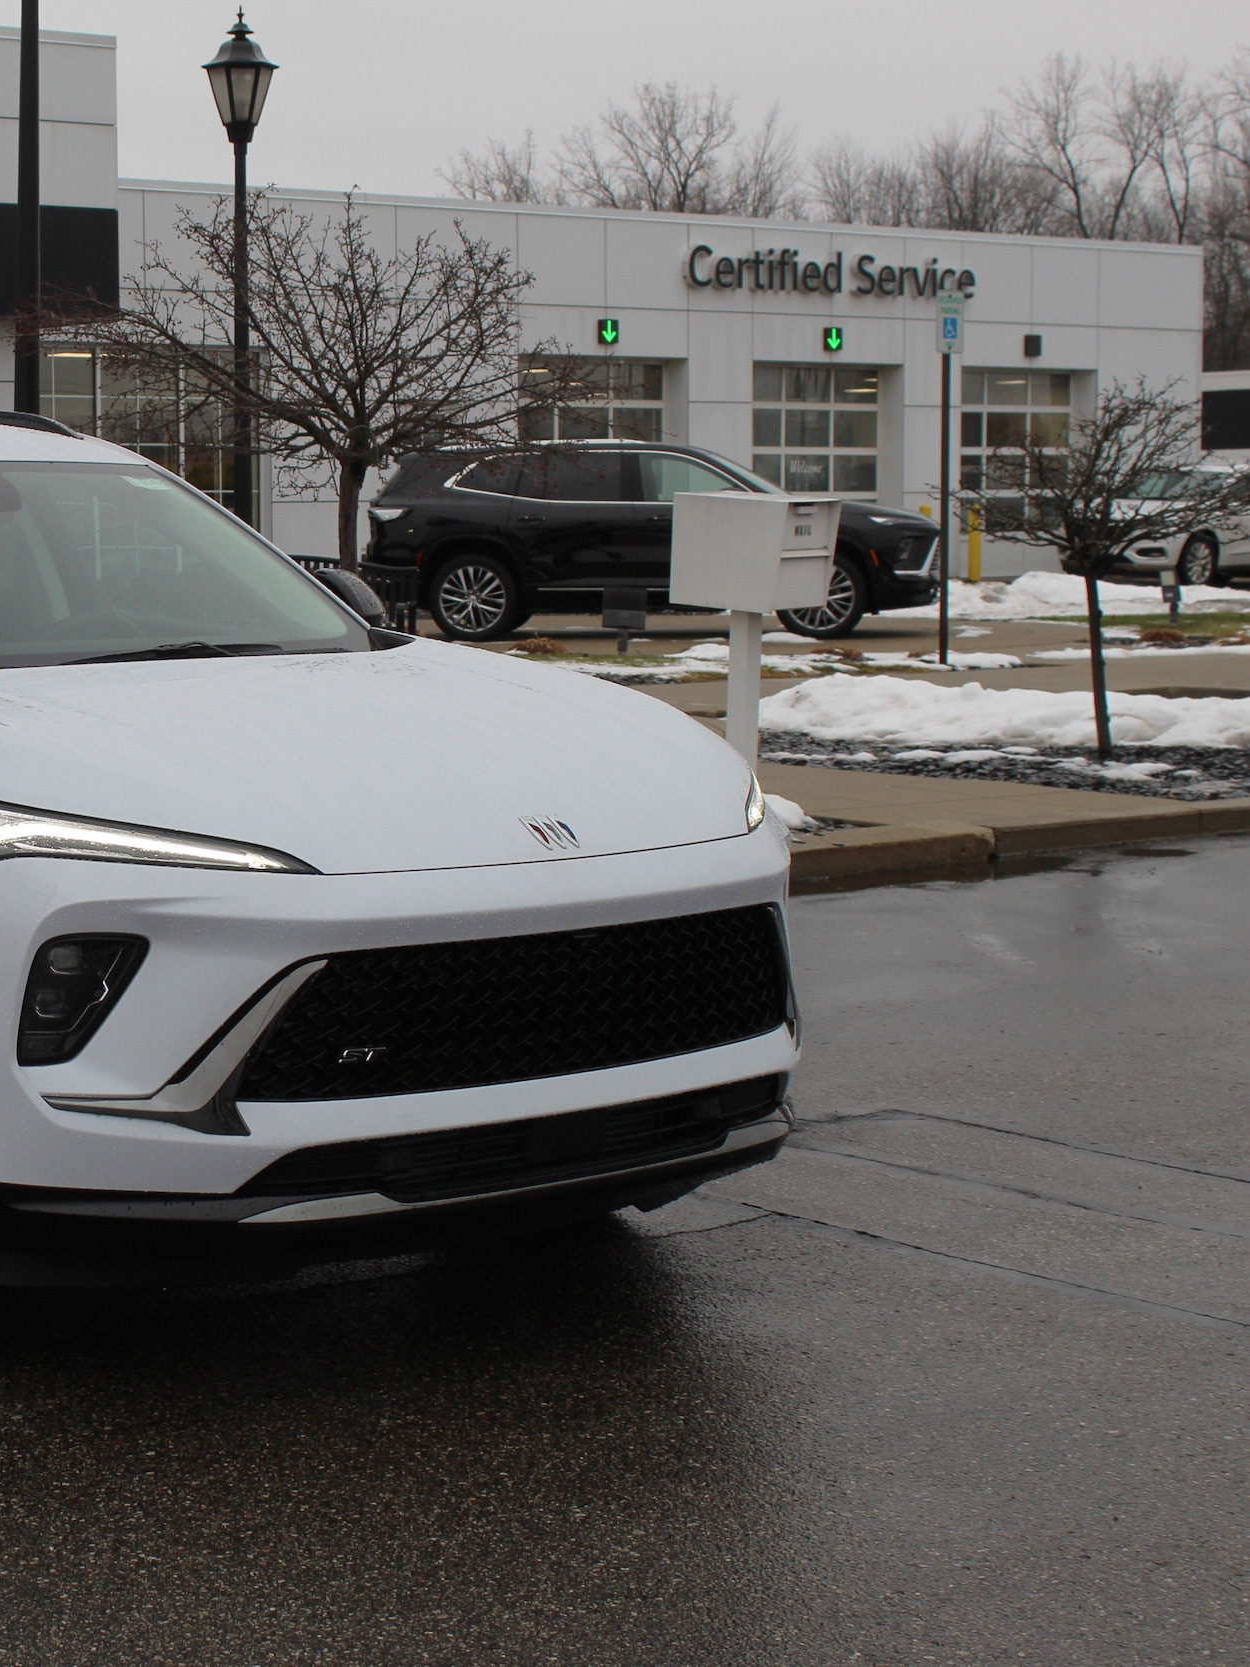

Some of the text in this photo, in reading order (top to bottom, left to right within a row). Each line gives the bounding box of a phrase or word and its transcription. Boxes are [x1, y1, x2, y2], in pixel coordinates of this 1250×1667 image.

[689, 244, 976, 300] Certified Service
[794, 524, 812, 536] MAIL
[338, 1047, 387, 1064] ST
